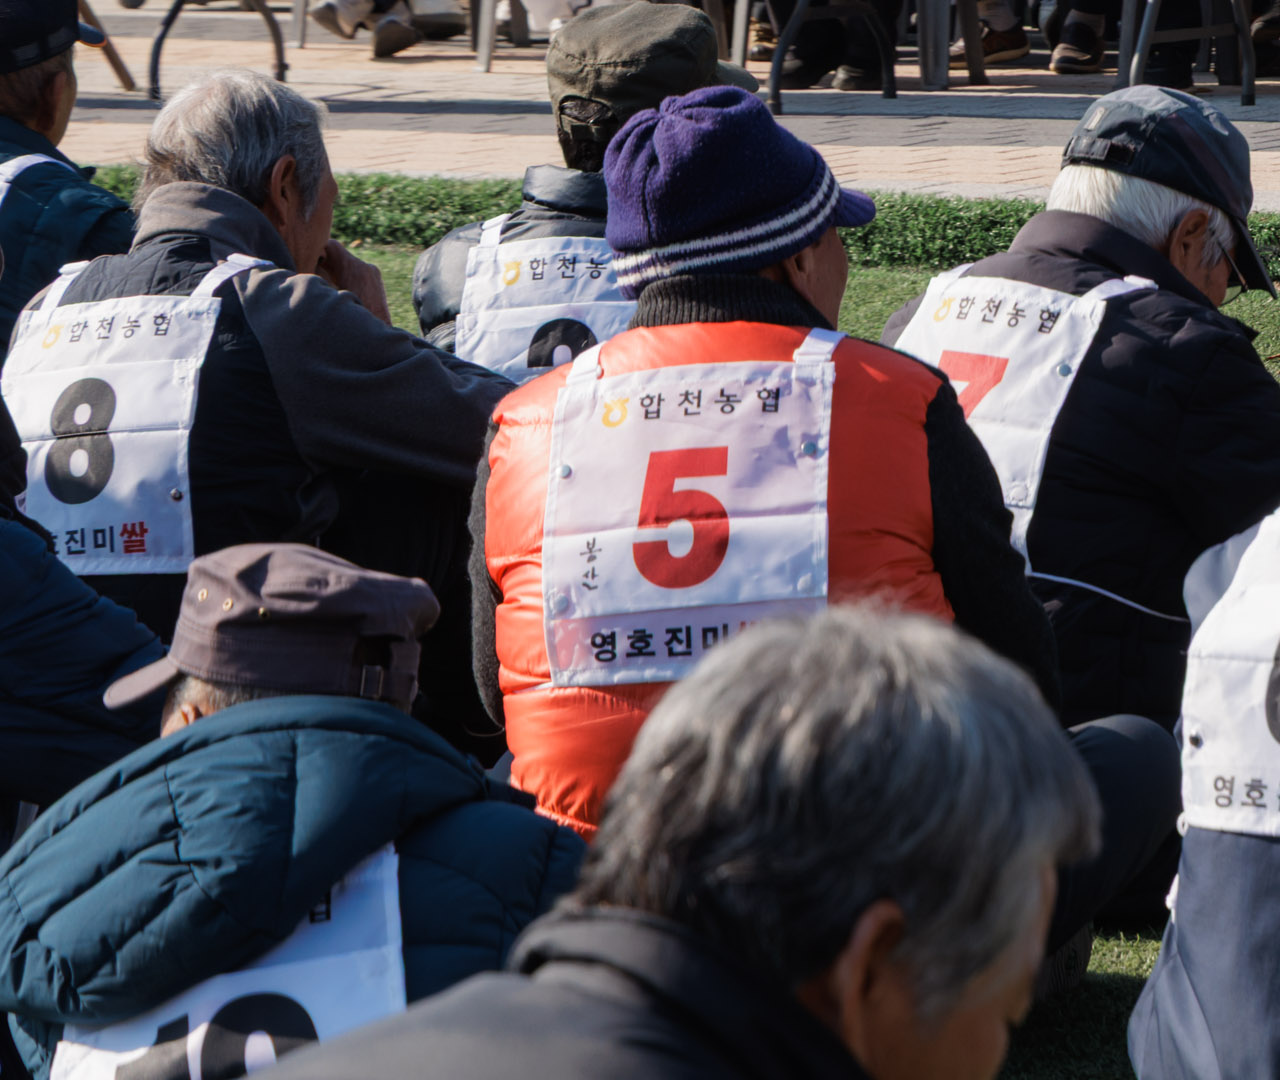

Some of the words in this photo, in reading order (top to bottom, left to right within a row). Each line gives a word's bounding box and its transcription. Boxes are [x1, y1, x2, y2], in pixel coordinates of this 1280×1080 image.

[67, 312, 174, 344] 합천농협
[956, 295, 1062, 334] 합천농협
[639, 386, 782, 420] 합천농협
[44, 377, 117, 505] 8
[632, 445, 731, 589] 5
[580, 537, 602, 591] 봉산
[590, 621, 755, 663] 영호진미
